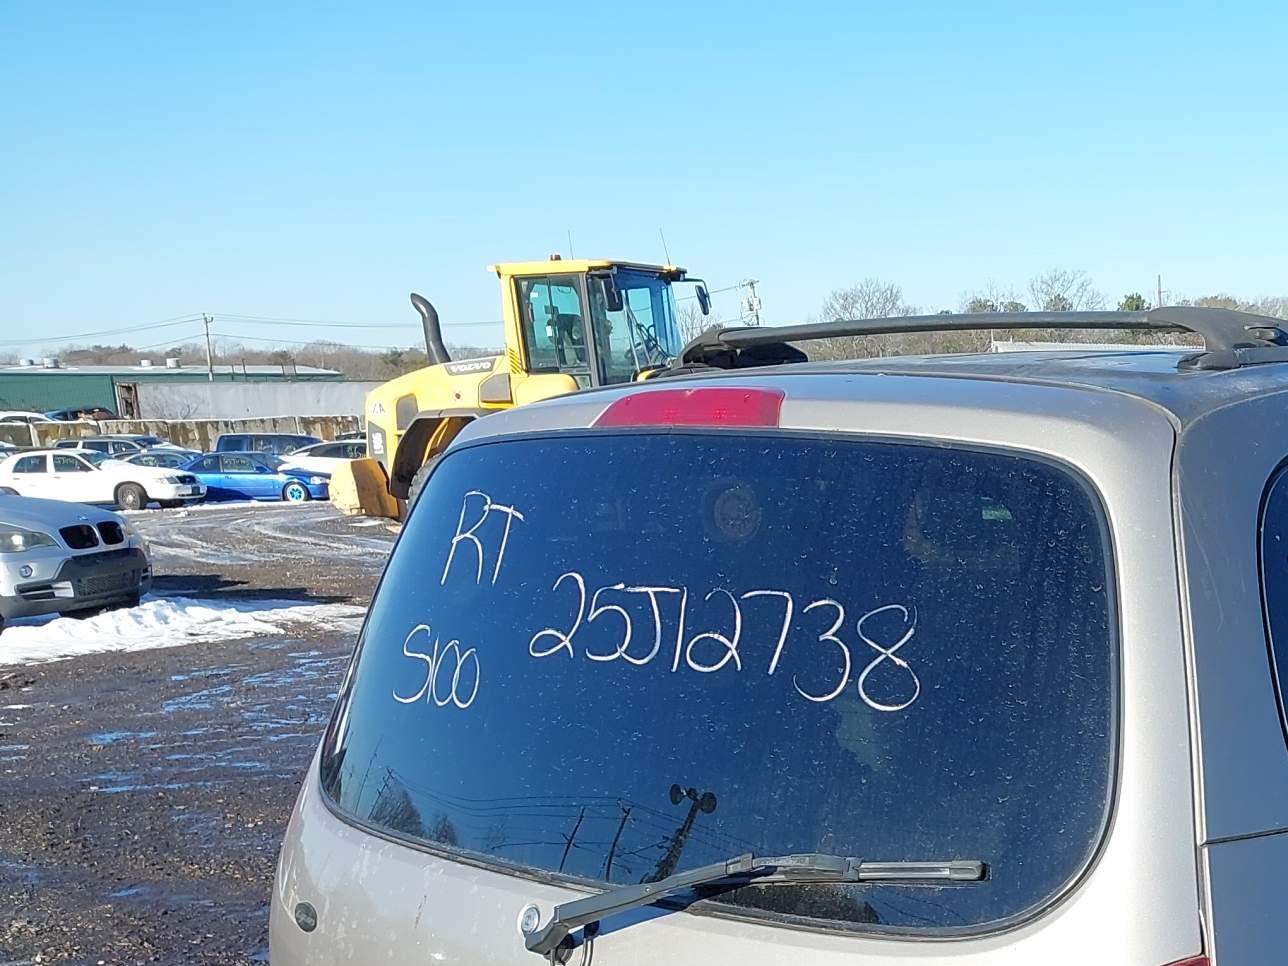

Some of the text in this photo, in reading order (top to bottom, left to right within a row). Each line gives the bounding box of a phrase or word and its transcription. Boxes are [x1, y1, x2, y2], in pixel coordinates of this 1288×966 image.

[449, 361, 492, 373] VOLVO
[440, 490, 526, 585] RT
[393, 624, 481, 708] S100
[529, 572, 921, 711] 25J12738
